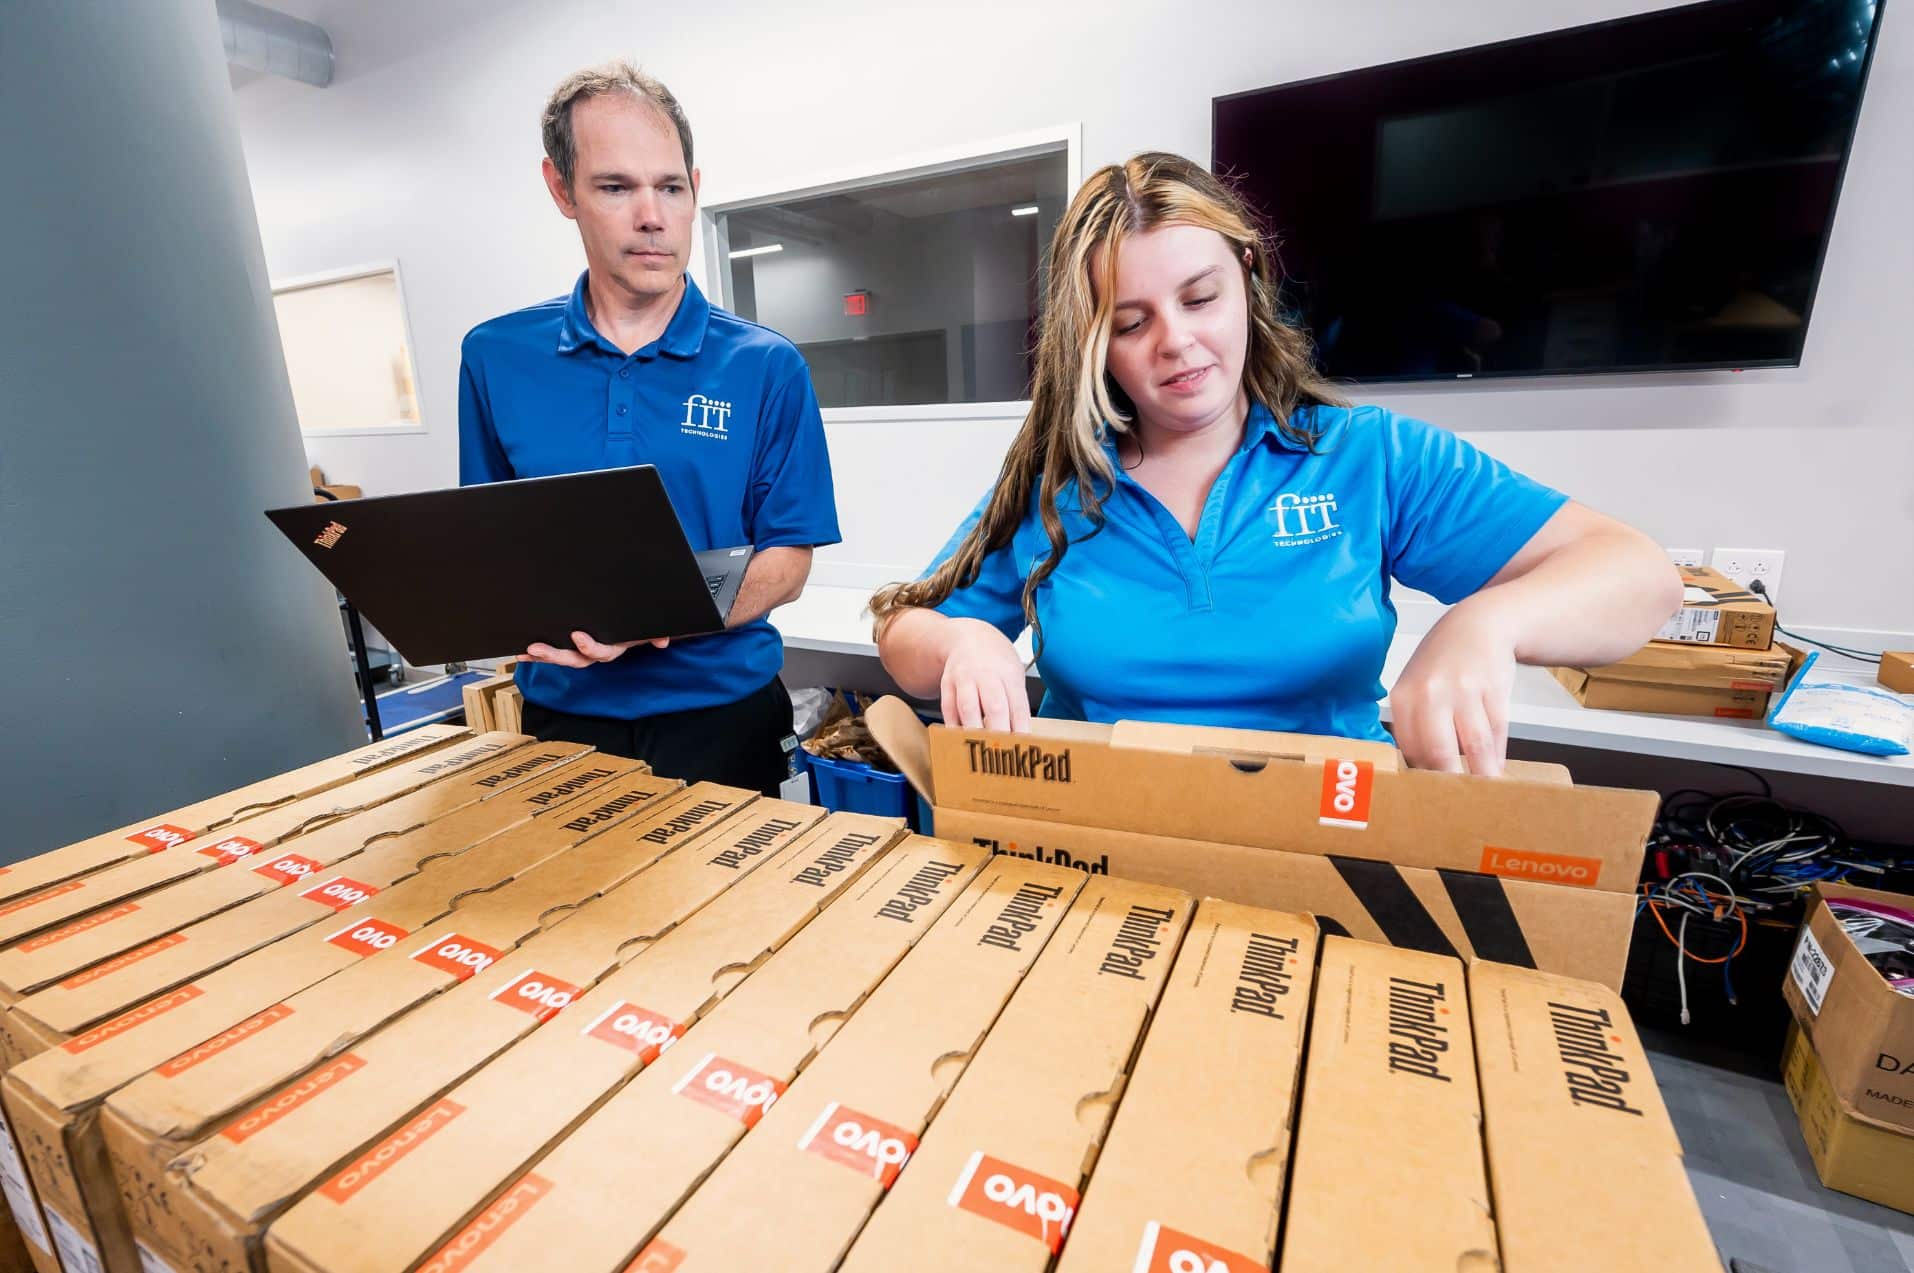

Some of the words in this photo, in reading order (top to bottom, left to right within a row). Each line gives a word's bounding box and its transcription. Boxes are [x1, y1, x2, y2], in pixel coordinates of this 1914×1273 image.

[313, 520, 348, 549] ThinkPad
[352, 735, 441, 765] ThinkPad
[420, 743, 507, 775] ThinkPad
[475, 754, 566, 788] ThinkPad
[965, 739, 1072, 783] ThinkPad
[526, 769, 618, 805] ThinkPad
[564, 790, 657, 832] ThinkPad
[641, 800, 732, 844] ThinkPad
[709, 818, 801, 869] ThinkPad
[792, 832, 881, 887] ThinkPad
[1491, 854, 1588, 879] Lenovo
[877, 860, 965, 923] ThinkPad
[979, 882, 1064, 952] ThinkPad
[1099, 905, 1175, 980] ThinkPad
[1232, 932, 1298, 1020] ThinkPad
[79, 991, 190, 1045] Lenovo
[171, 1010, 281, 1070] Lenovo
[1388, 976, 1452, 1083] ThinkPad
[1547, 1001, 1644, 1117] ThinkPad
[239, 1061, 352, 1131] Lenovo
[1865, 1089, 1914, 1109] MADE
[338, 1106, 452, 1190] Lenovo
[833, 1121, 909, 1169] ovo
